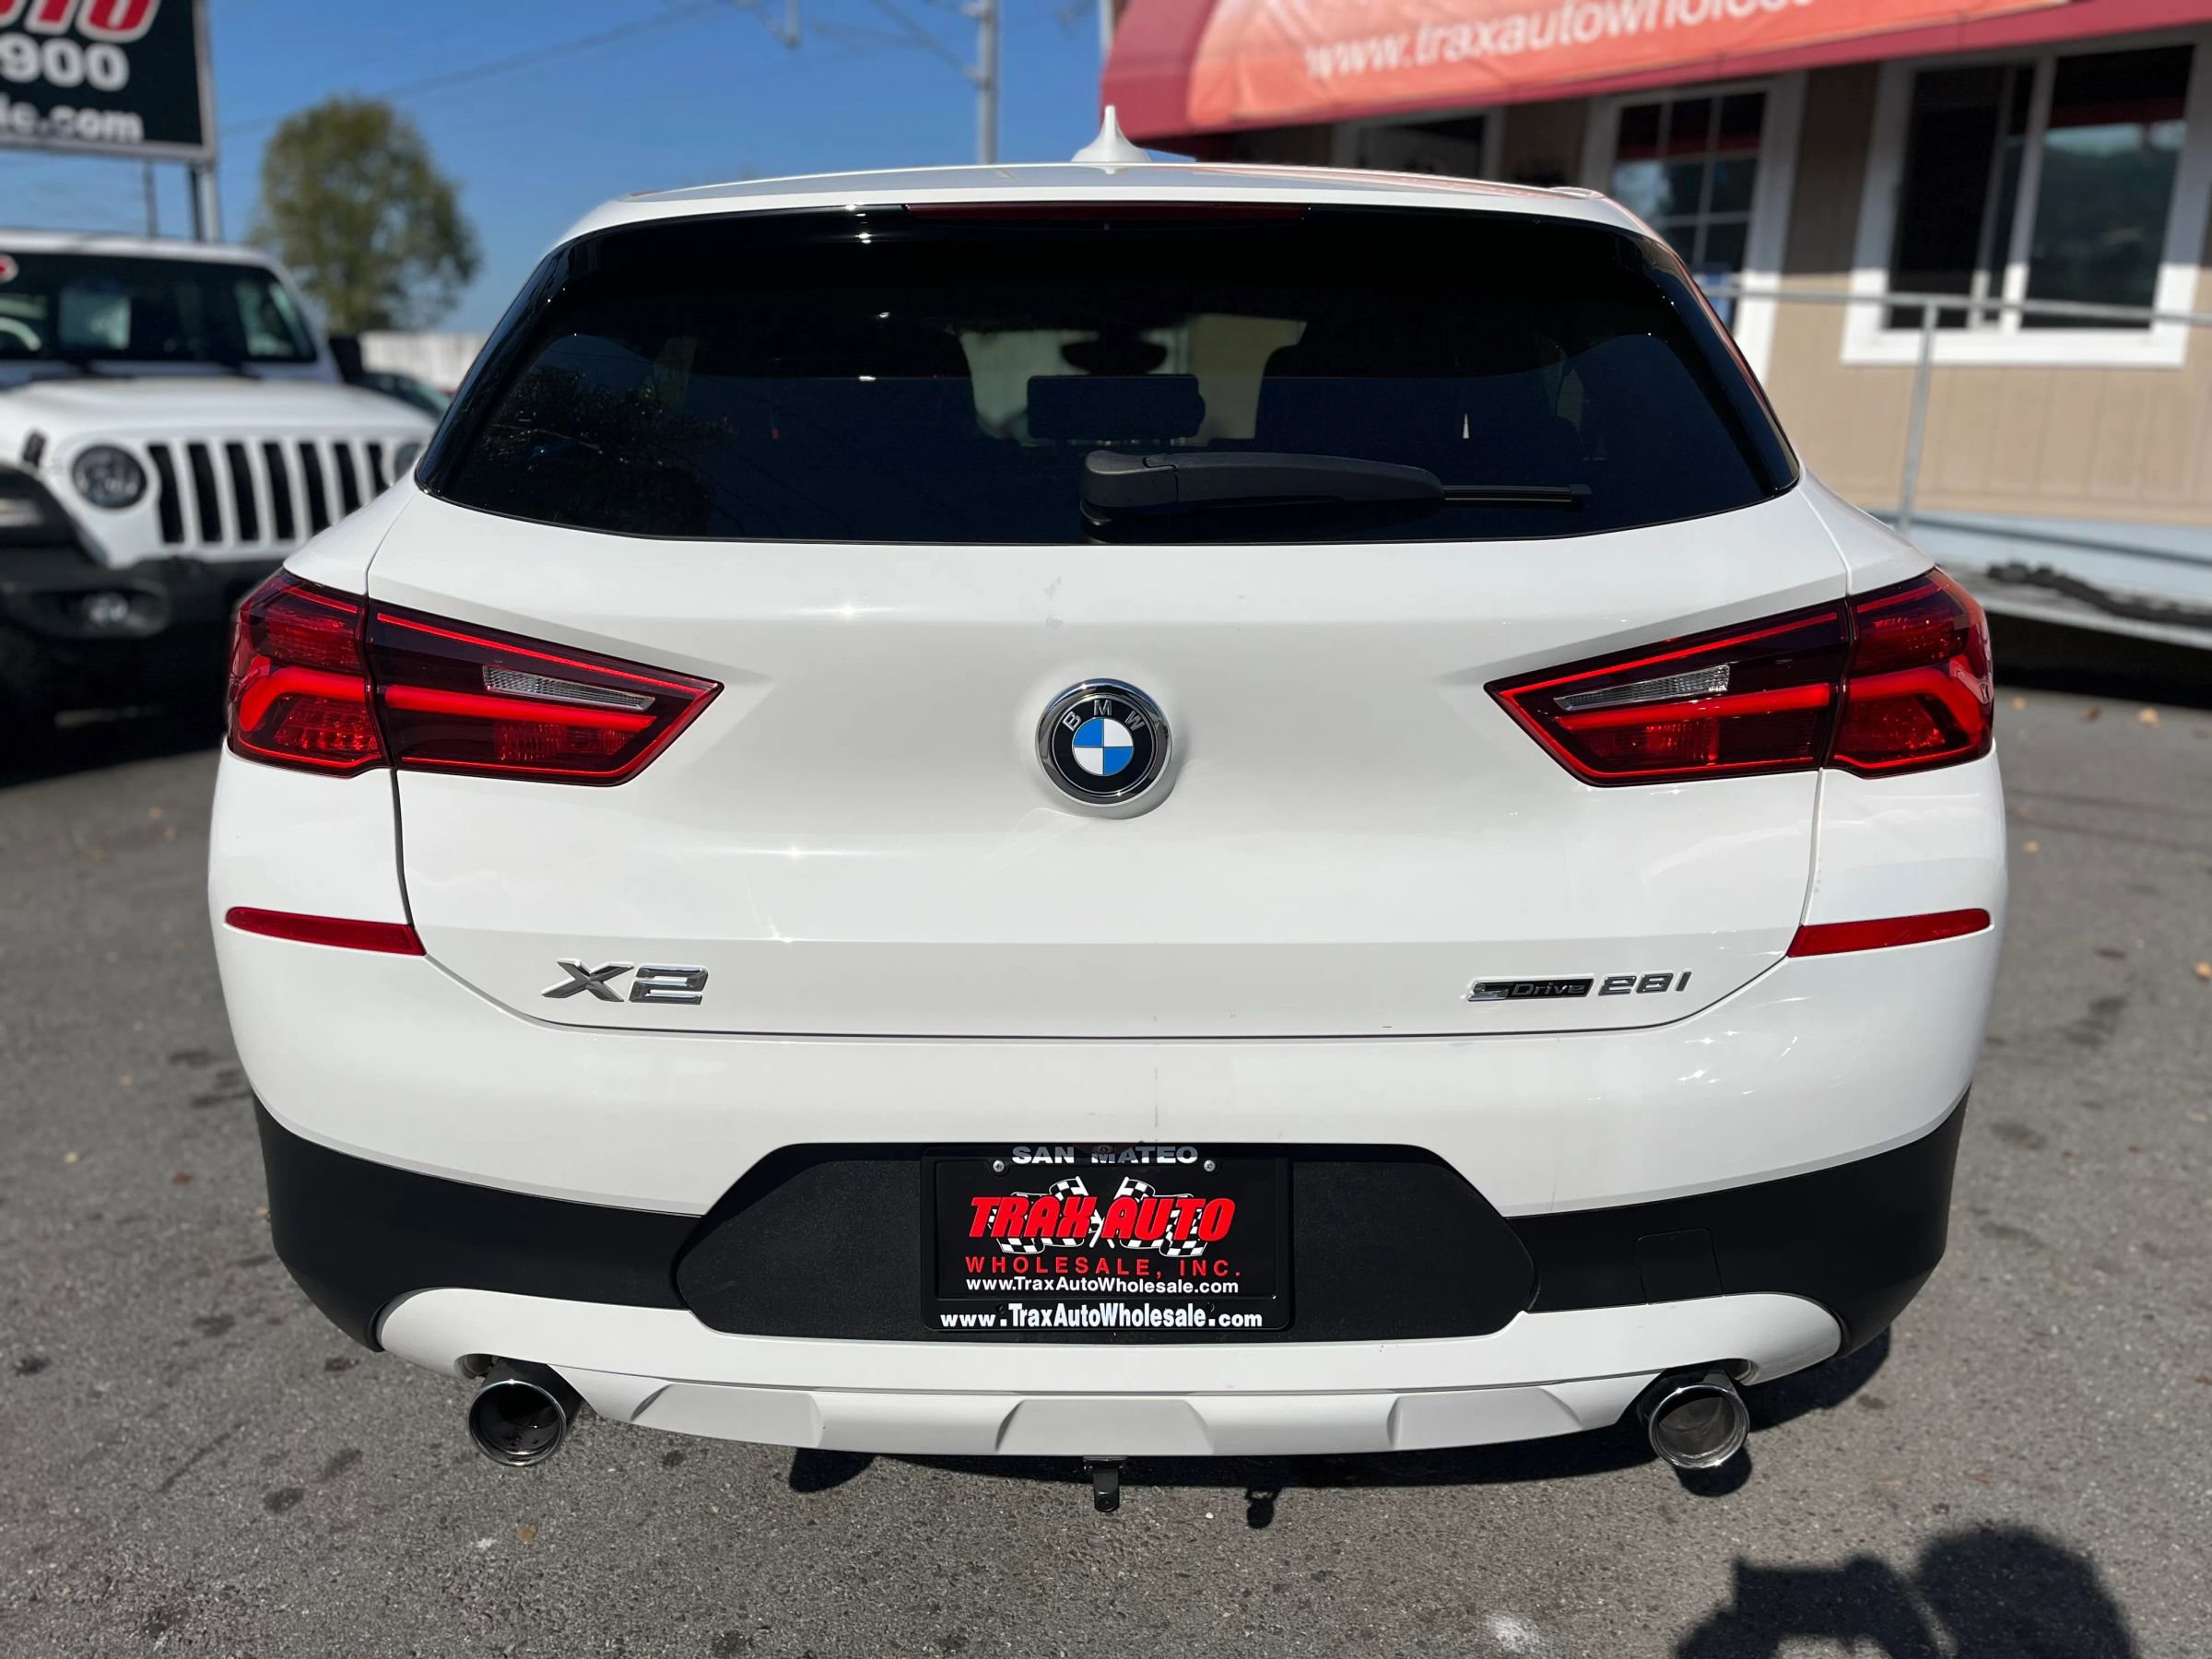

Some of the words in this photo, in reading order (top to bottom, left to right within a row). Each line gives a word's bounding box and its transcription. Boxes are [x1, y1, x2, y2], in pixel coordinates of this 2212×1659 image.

[1062, 699, 1146, 732] BMW
[541, 958, 708, 1005] X2
[1012, 1146, 1075, 1164] SAN
[1091, 1146, 1197, 1164] MATEO
[969, 1195, 1098, 1239] TRAX
[1101, 1197, 1236, 1241] AUTO
[965, 1256, 1163, 1278] WHOLESALE,
[1180, 1260, 1241, 1277] INC.
[966, 1276, 1239, 1294] www.TraxAutoWholesale.com
[940, 1301, 1263, 1328] www.TraxAutoWholesale.com
